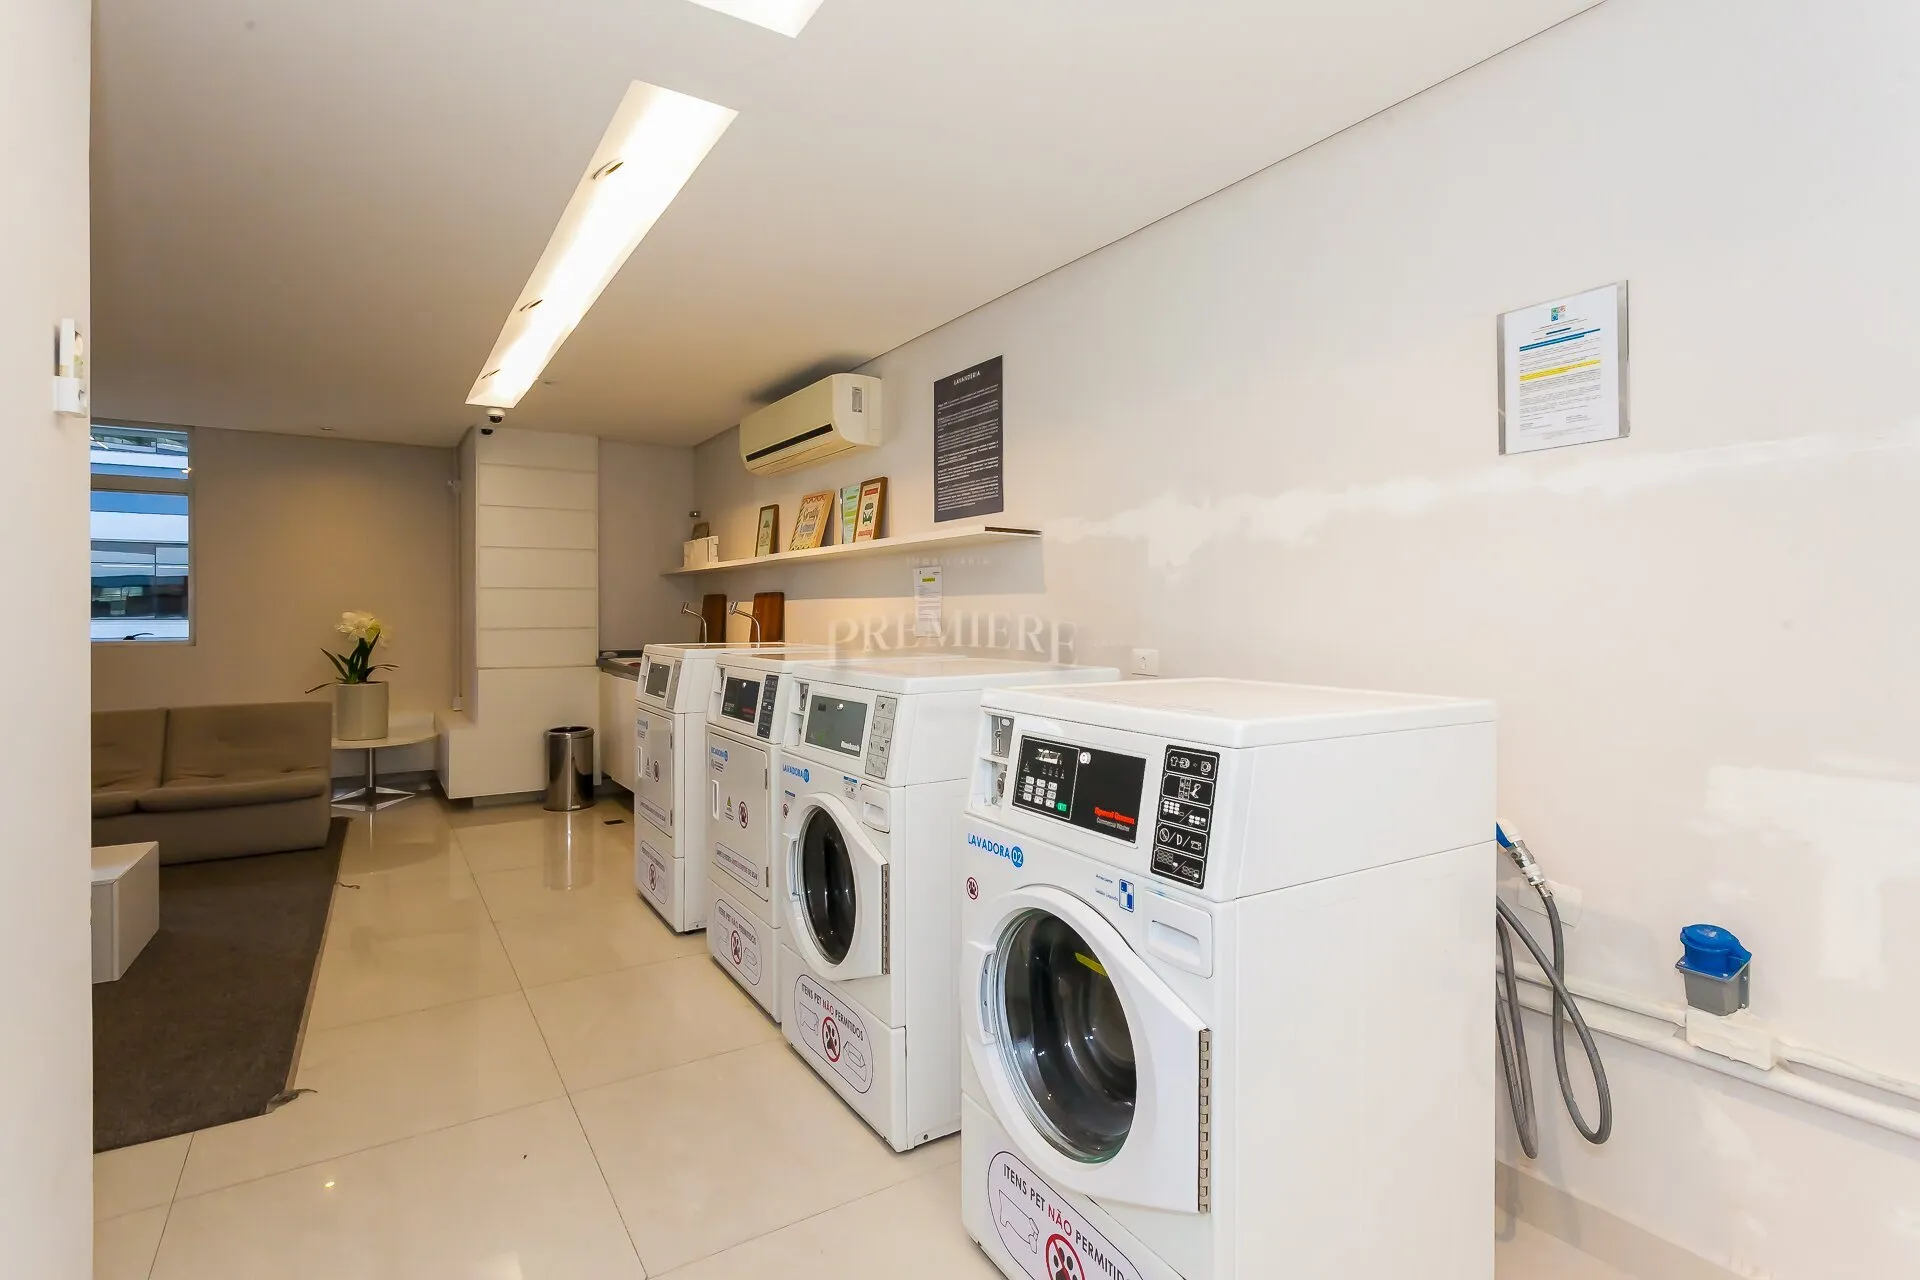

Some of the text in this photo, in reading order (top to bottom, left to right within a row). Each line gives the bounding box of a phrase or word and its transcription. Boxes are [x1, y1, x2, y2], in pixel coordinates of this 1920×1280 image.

[953, 370, 981, 386] LAVANDERIA
[967, 833, 1023, 865] LAVADORA 02
[801, 982, 864, 1042] ITENS PET NÃO PERMITIDOS
[1003, 1163, 1131, 1280] ITENS PET NÃO PERMITID
